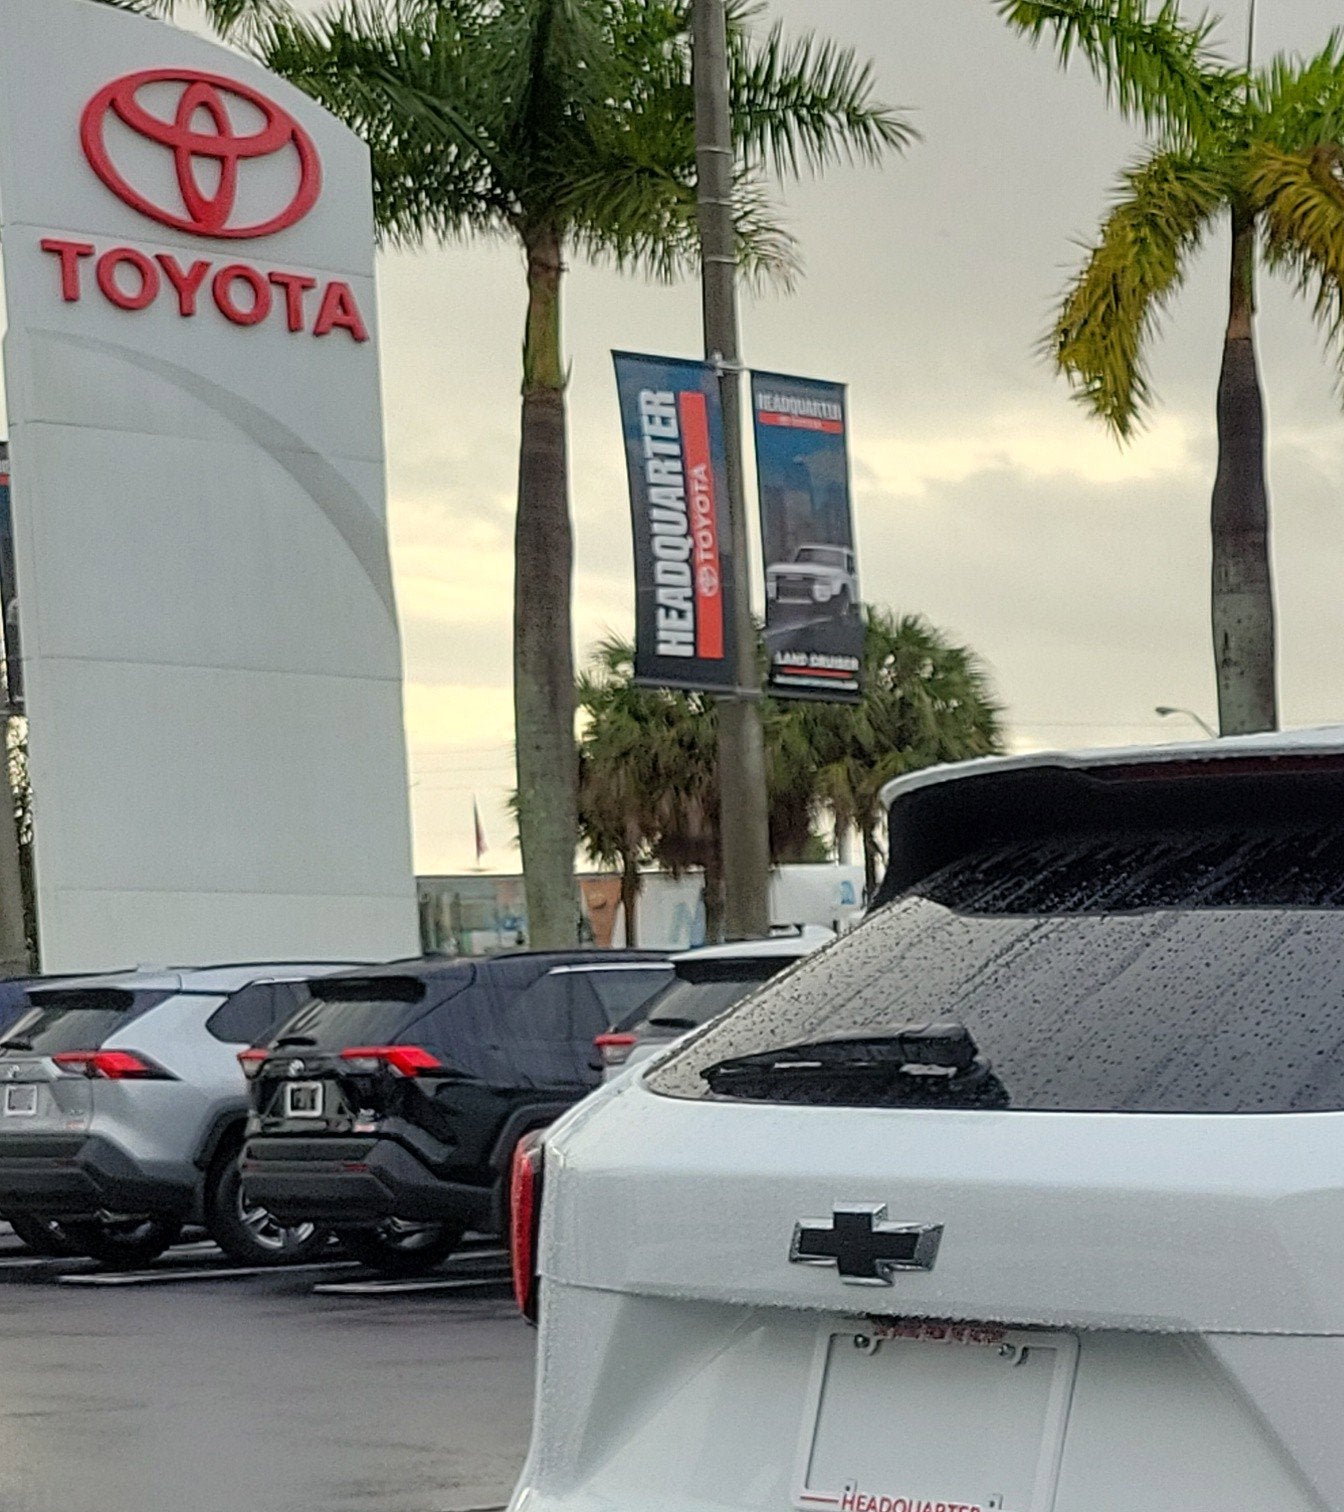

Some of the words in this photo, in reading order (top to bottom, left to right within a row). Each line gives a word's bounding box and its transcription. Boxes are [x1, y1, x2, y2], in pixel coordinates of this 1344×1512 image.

[40, 239, 370, 343] TOYOTA
[638, 390, 695, 657] HEADQUARTER
[692, 463, 714, 561] TOYOTA
